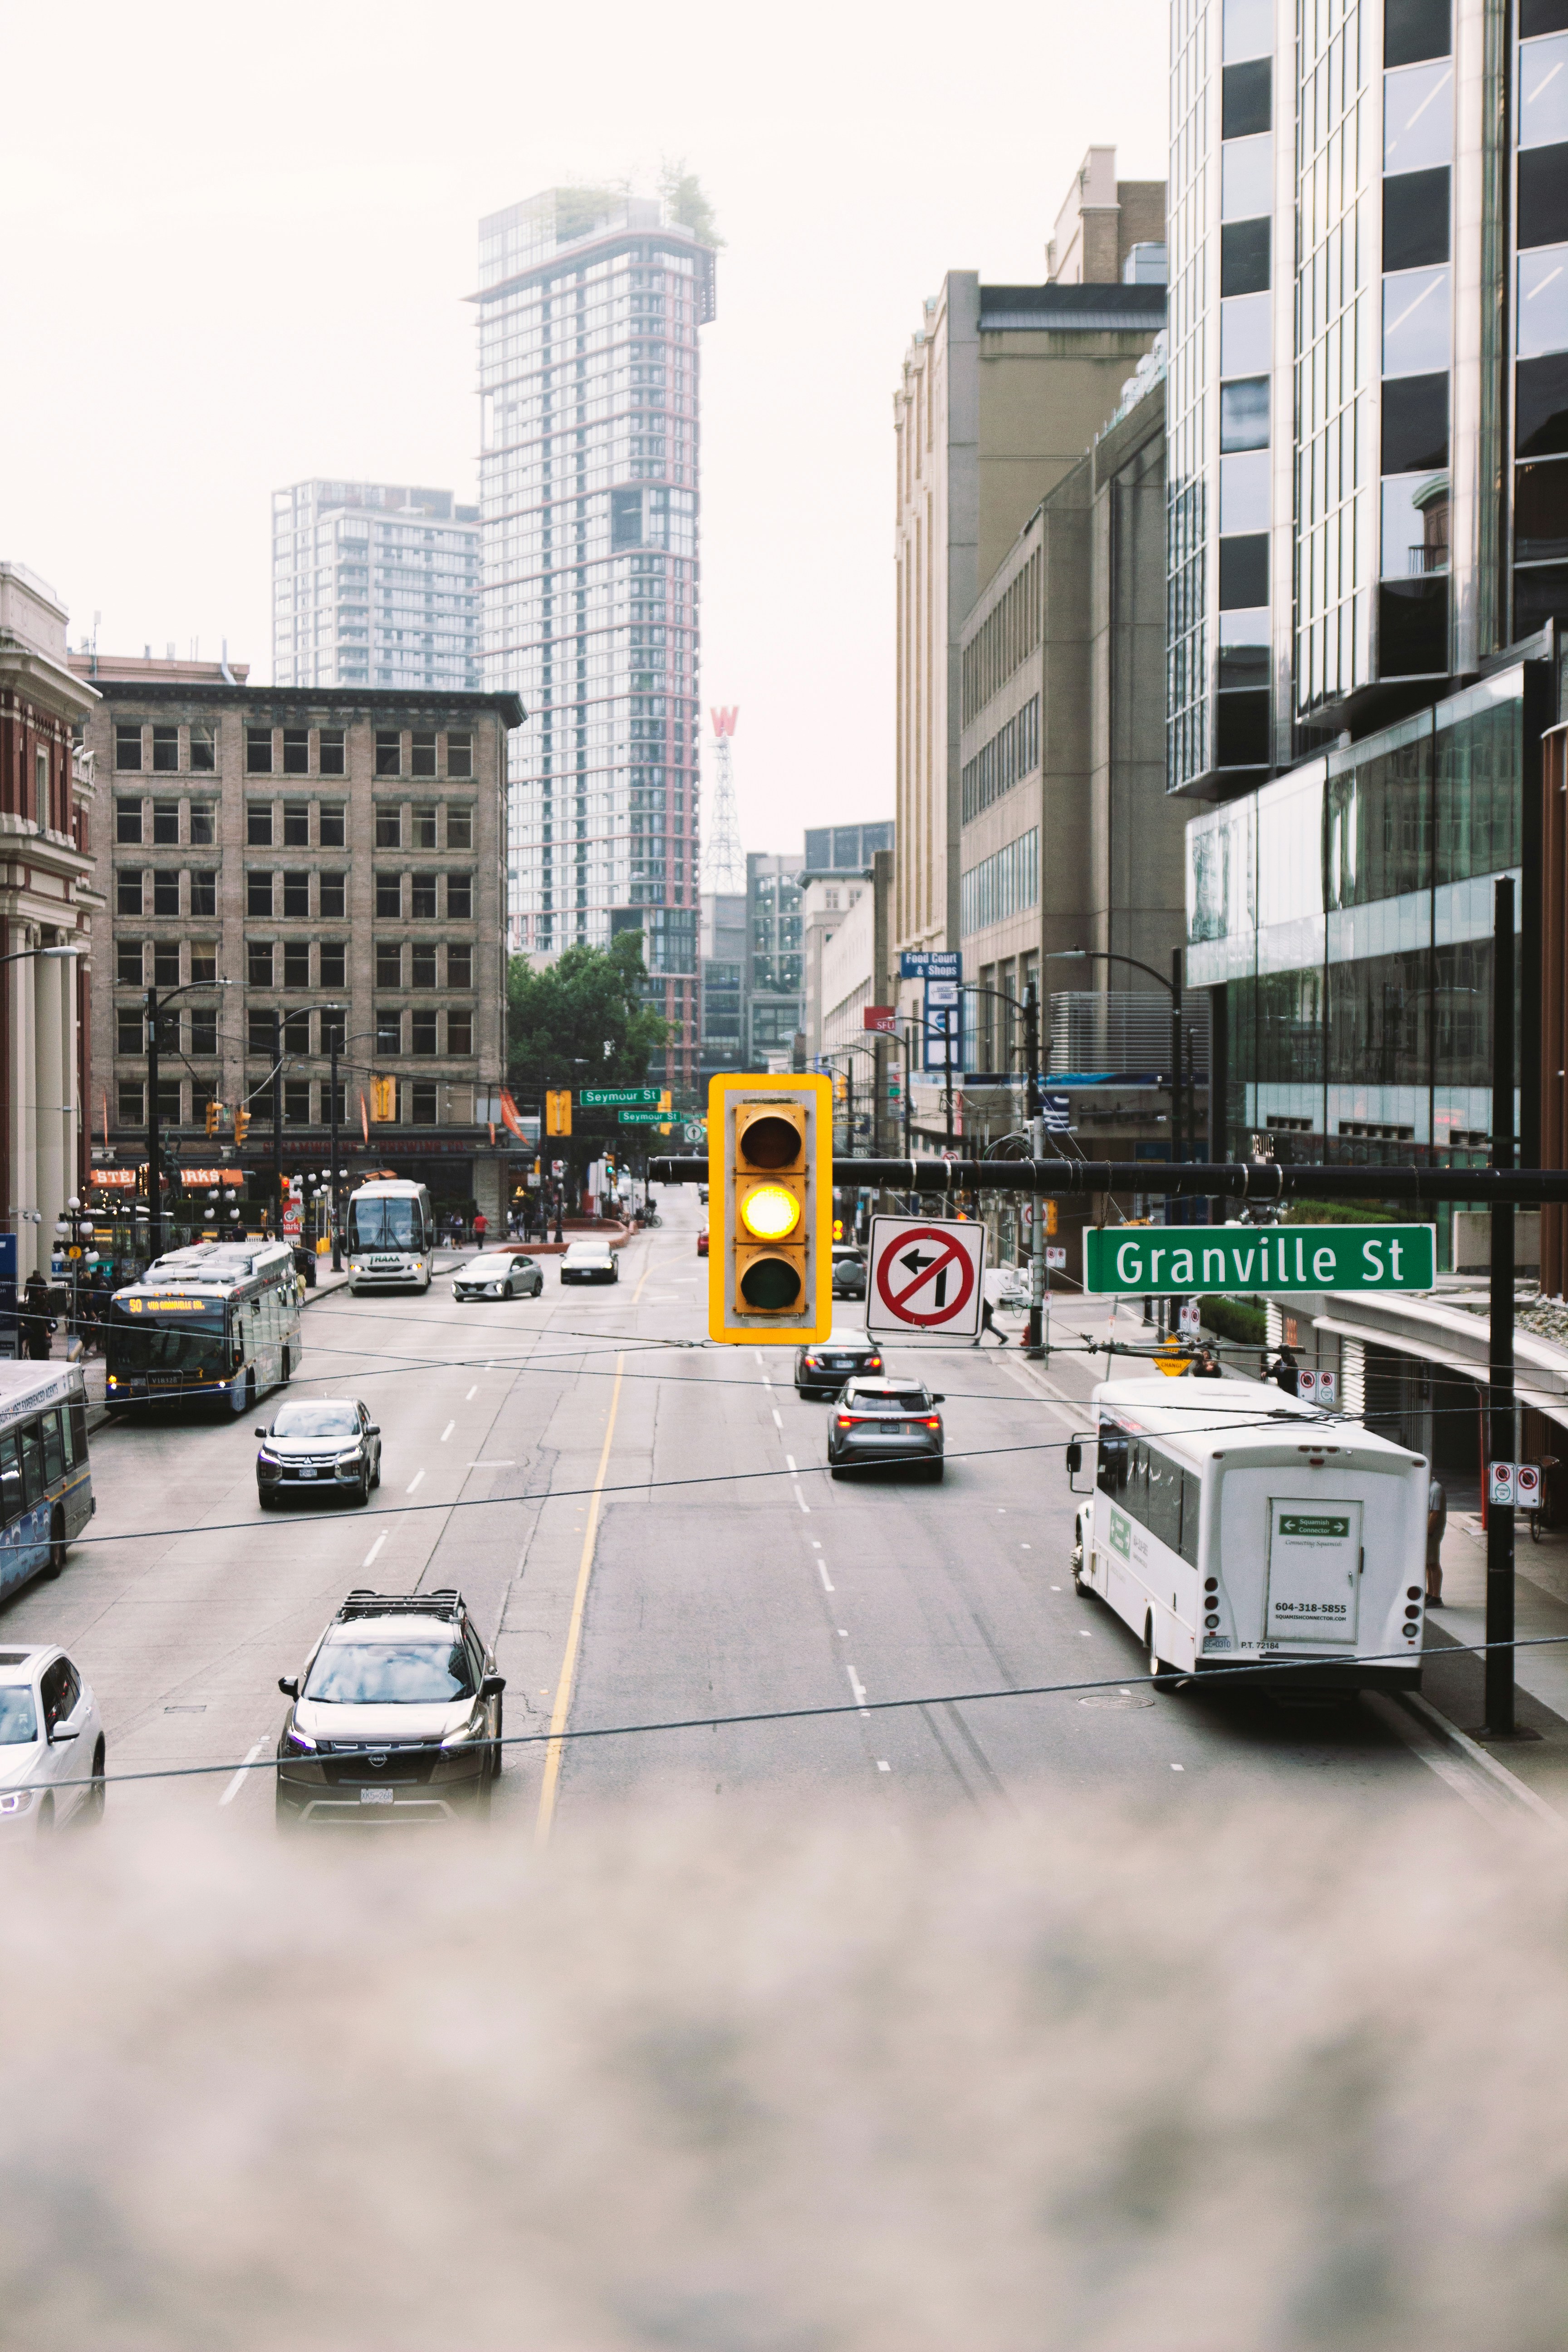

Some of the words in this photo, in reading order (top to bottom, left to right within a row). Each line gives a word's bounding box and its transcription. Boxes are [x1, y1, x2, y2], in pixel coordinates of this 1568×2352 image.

[710, 706, 740, 737] W
[906, 953, 929, 963] Food
[931, 953, 957, 963] Court
[917, 965, 924, 975] &
[928, 965, 957, 975] Shops
[877, 1021, 895, 1029] SFU
[586, 1092, 637, 1102] Seymour
[643, 1090, 656, 1099] St
[623, 1112, 662, 1121] Seymour
[369, 1255, 400, 1265] TRAXX
[1117, 1237, 1337, 1284] Granville
[1362, 1239, 1404, 1281] St
[129, 1299, 142, 1313] 50
[147, 1301, 159, 1310] VIA
[160, 1301, 192, 1310] GRANVILLE
[1285, 1539, 1315, 1548] Connecting
[1275, 1602, 1347, 1613] 604-318-5855
